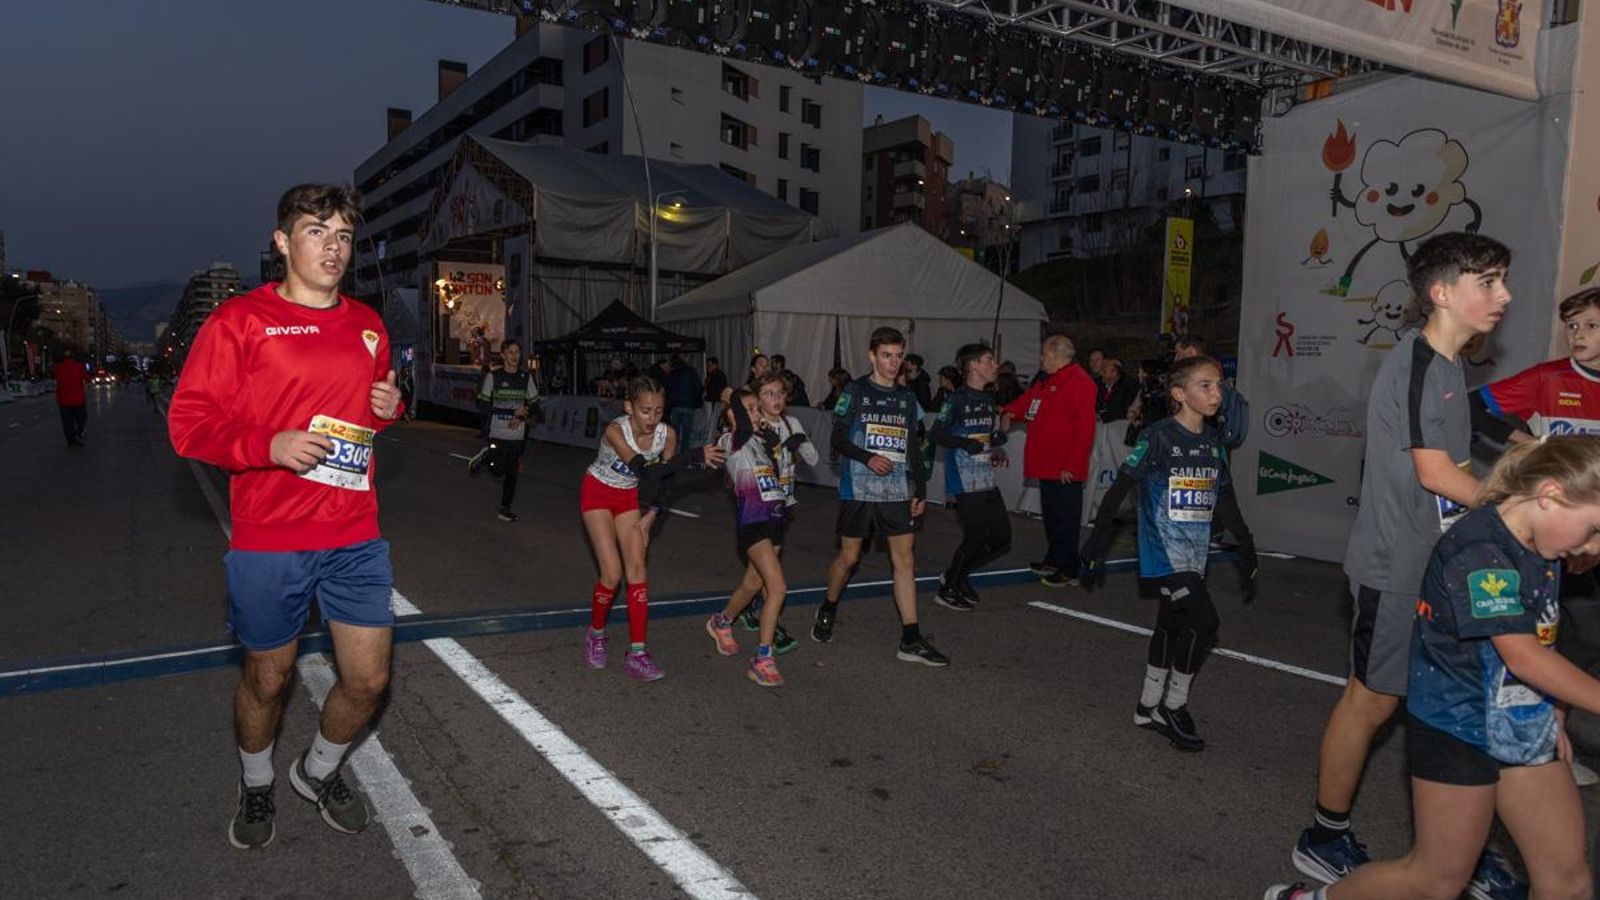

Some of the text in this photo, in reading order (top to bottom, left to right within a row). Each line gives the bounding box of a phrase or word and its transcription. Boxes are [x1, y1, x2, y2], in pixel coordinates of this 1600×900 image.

[449, 271, 493, 284] 42 SAN
[449, 283, 493, 296] NTON
[265, 325, 320, 336] GIVOVA
[861, 413, 880, 424] SAN
[330, 423, 347, 437] 42
[868, 434, 907, 450] 10336
[1170, 467, 1194, 478] SAN
